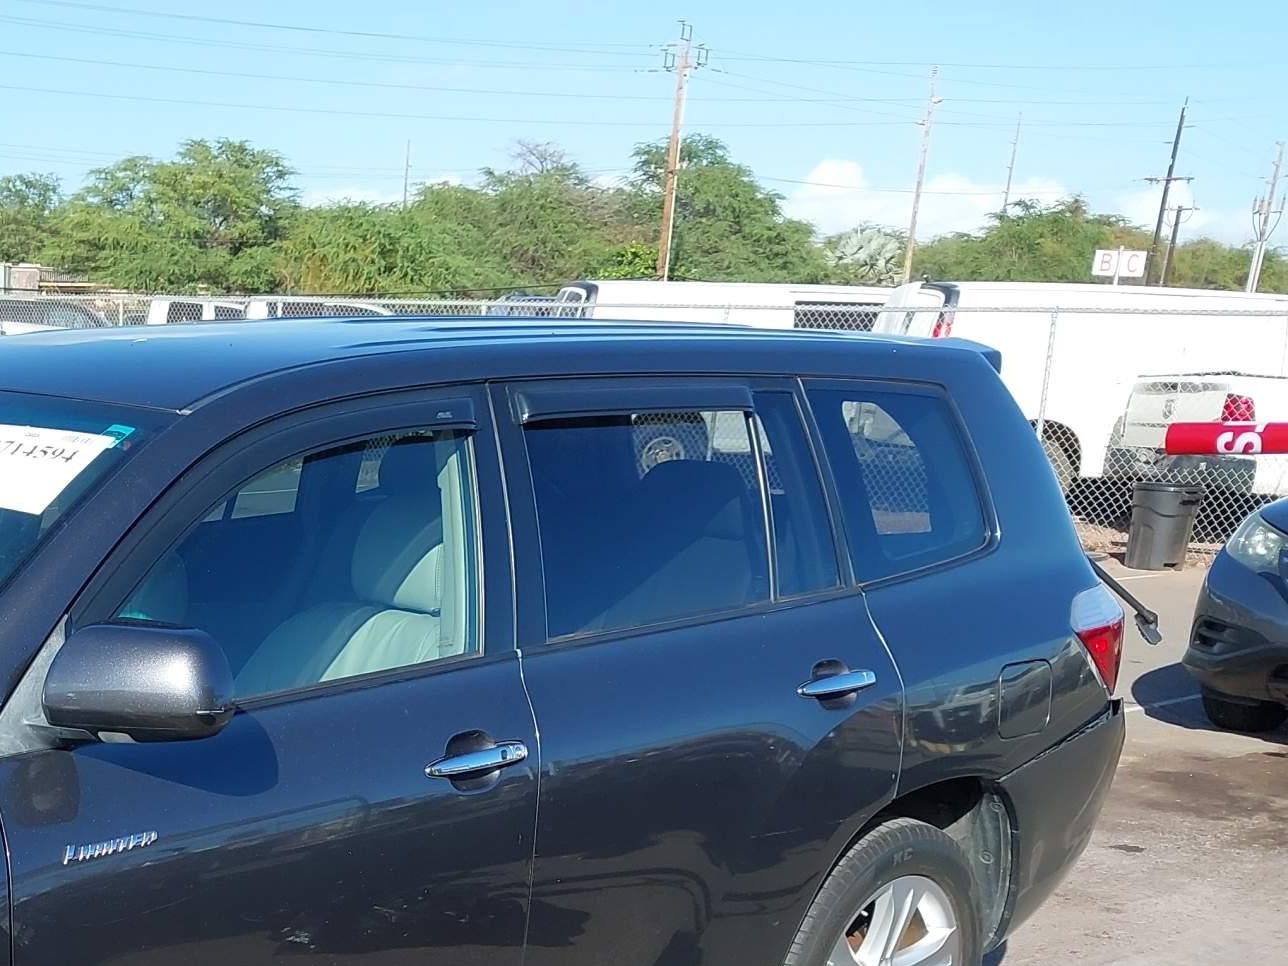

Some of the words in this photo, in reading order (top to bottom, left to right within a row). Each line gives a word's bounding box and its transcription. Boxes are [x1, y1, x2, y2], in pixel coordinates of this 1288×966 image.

[1100, 252, 1113, 272] B
[1127, 253, 1140, 273] C
[62, 829, 159, 865] LIMITED
